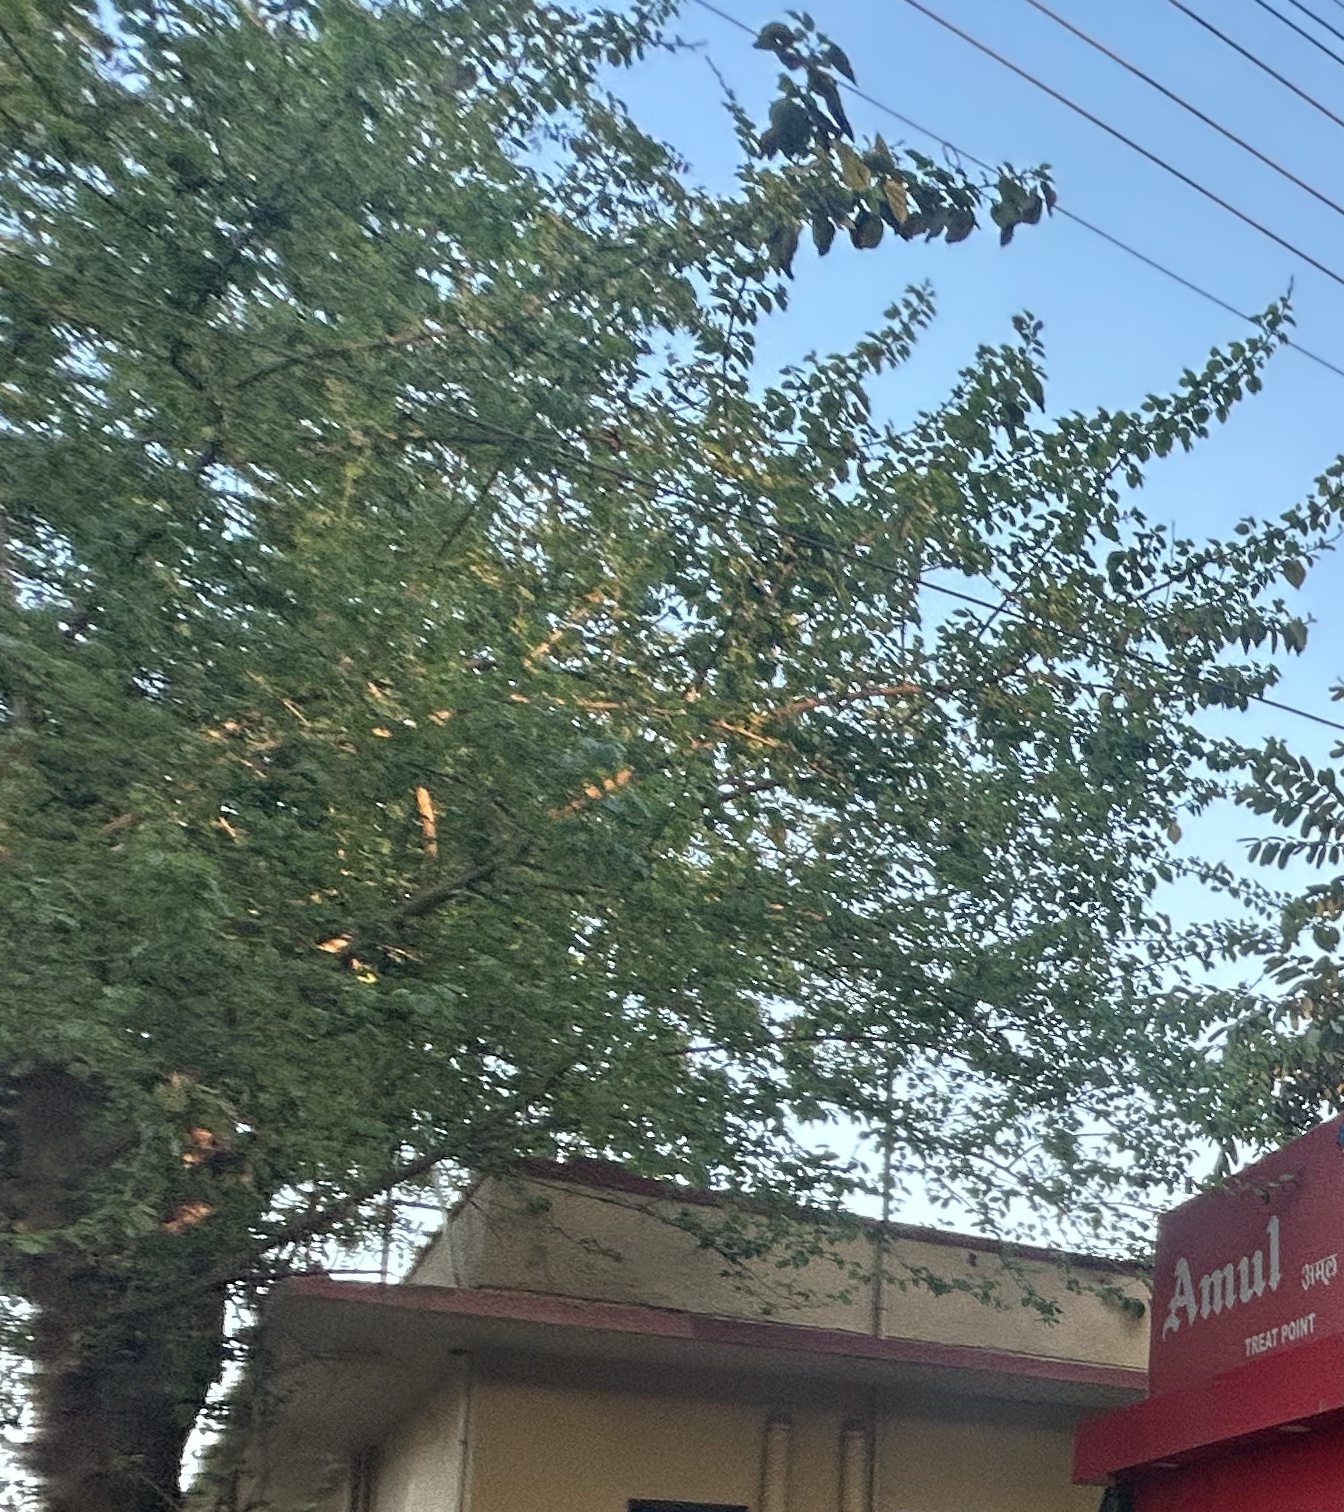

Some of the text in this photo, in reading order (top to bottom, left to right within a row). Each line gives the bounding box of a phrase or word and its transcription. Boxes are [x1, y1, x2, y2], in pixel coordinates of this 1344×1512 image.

[1162, 1214, 1283, 1342] Amul
[1244, 1312, 1317, 1357] TREAT POINT
